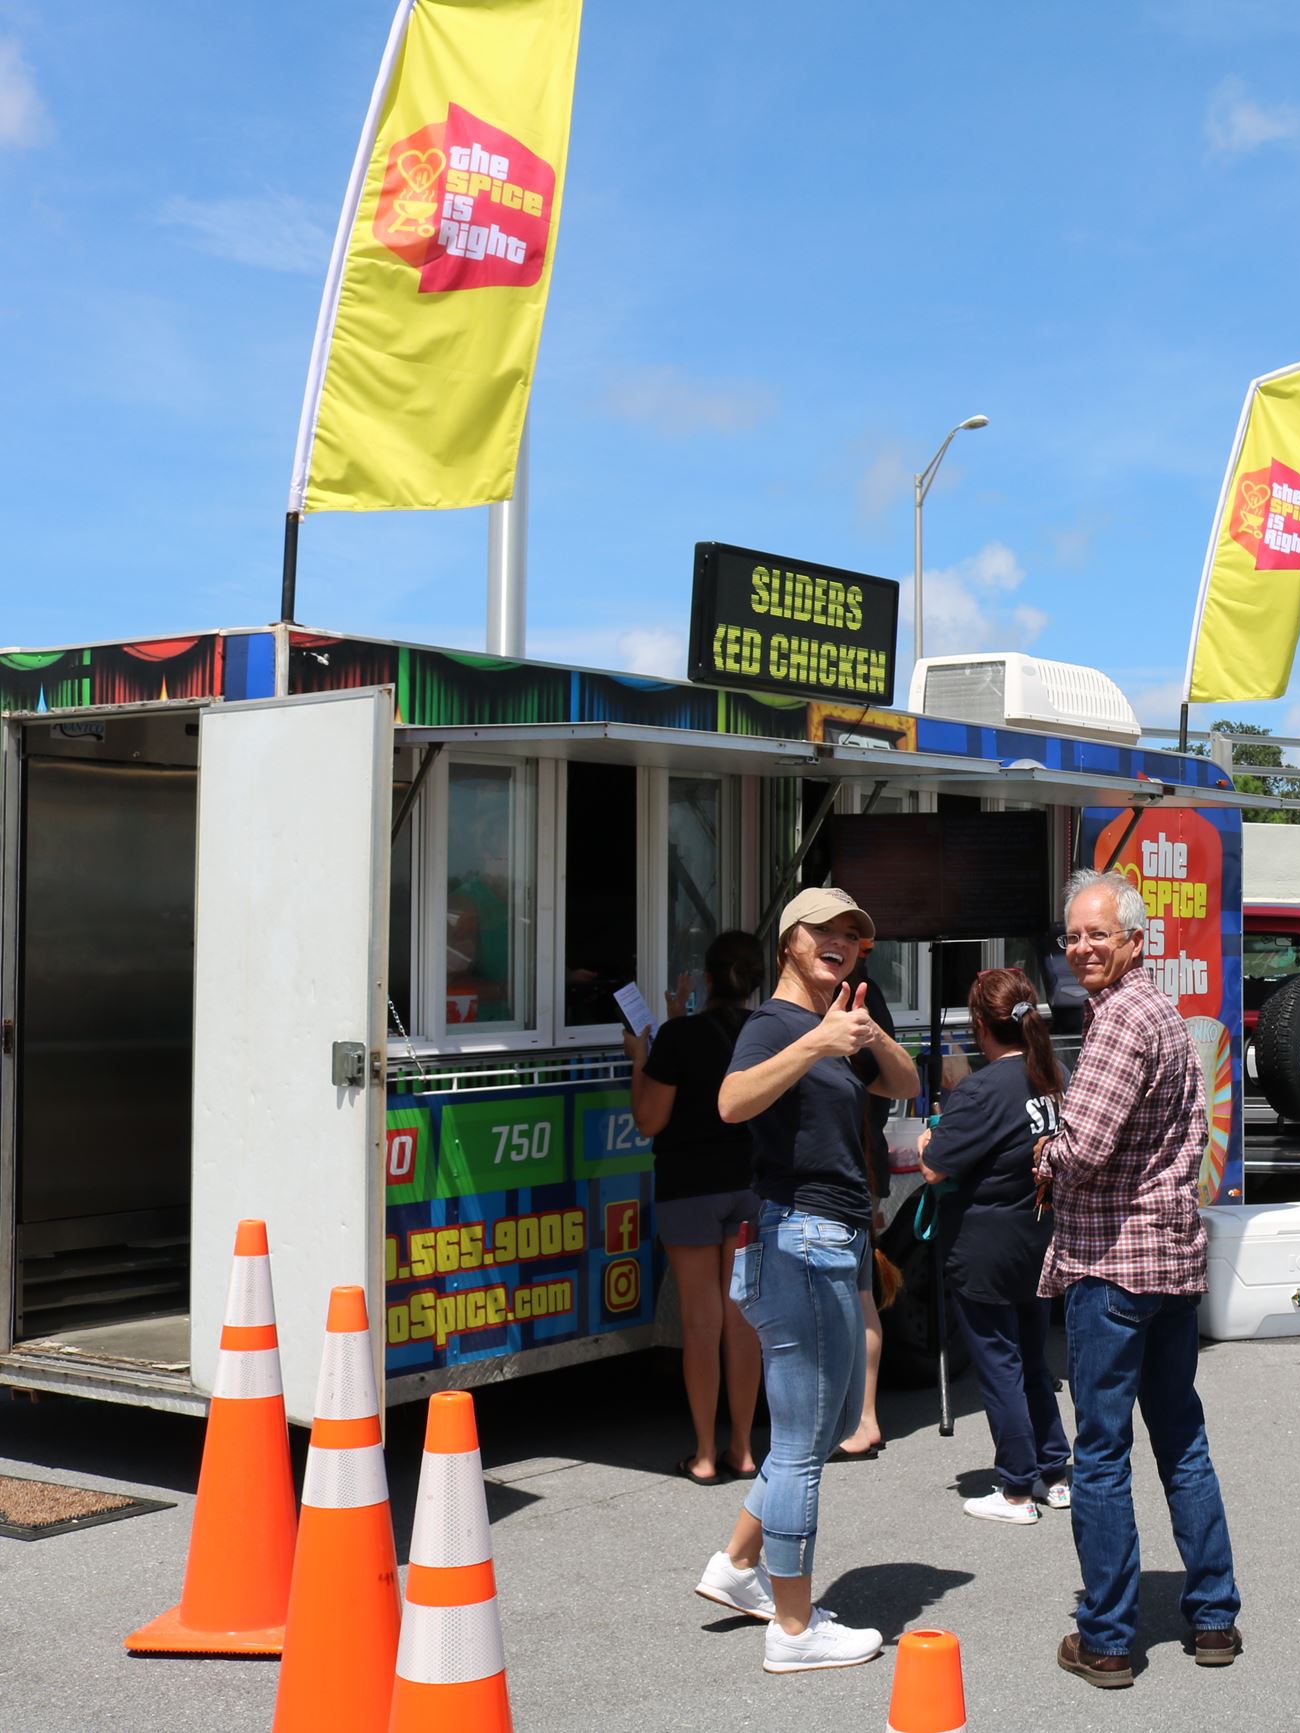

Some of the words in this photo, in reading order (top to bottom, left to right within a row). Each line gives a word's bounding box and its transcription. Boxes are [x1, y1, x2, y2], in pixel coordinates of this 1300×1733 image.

[449, 142, 509, 181] the
[441, 193, 474, 221] is
[437, 218, 527, 265] Right
[1267, 513, 1285, 531] is
[751, 565, 863, 631] SLIDERS
[769, 633, 887, 695] CHICKEN
[1141, 832, 1187, 879] the
[491, 1121, 552, 1164] 750
